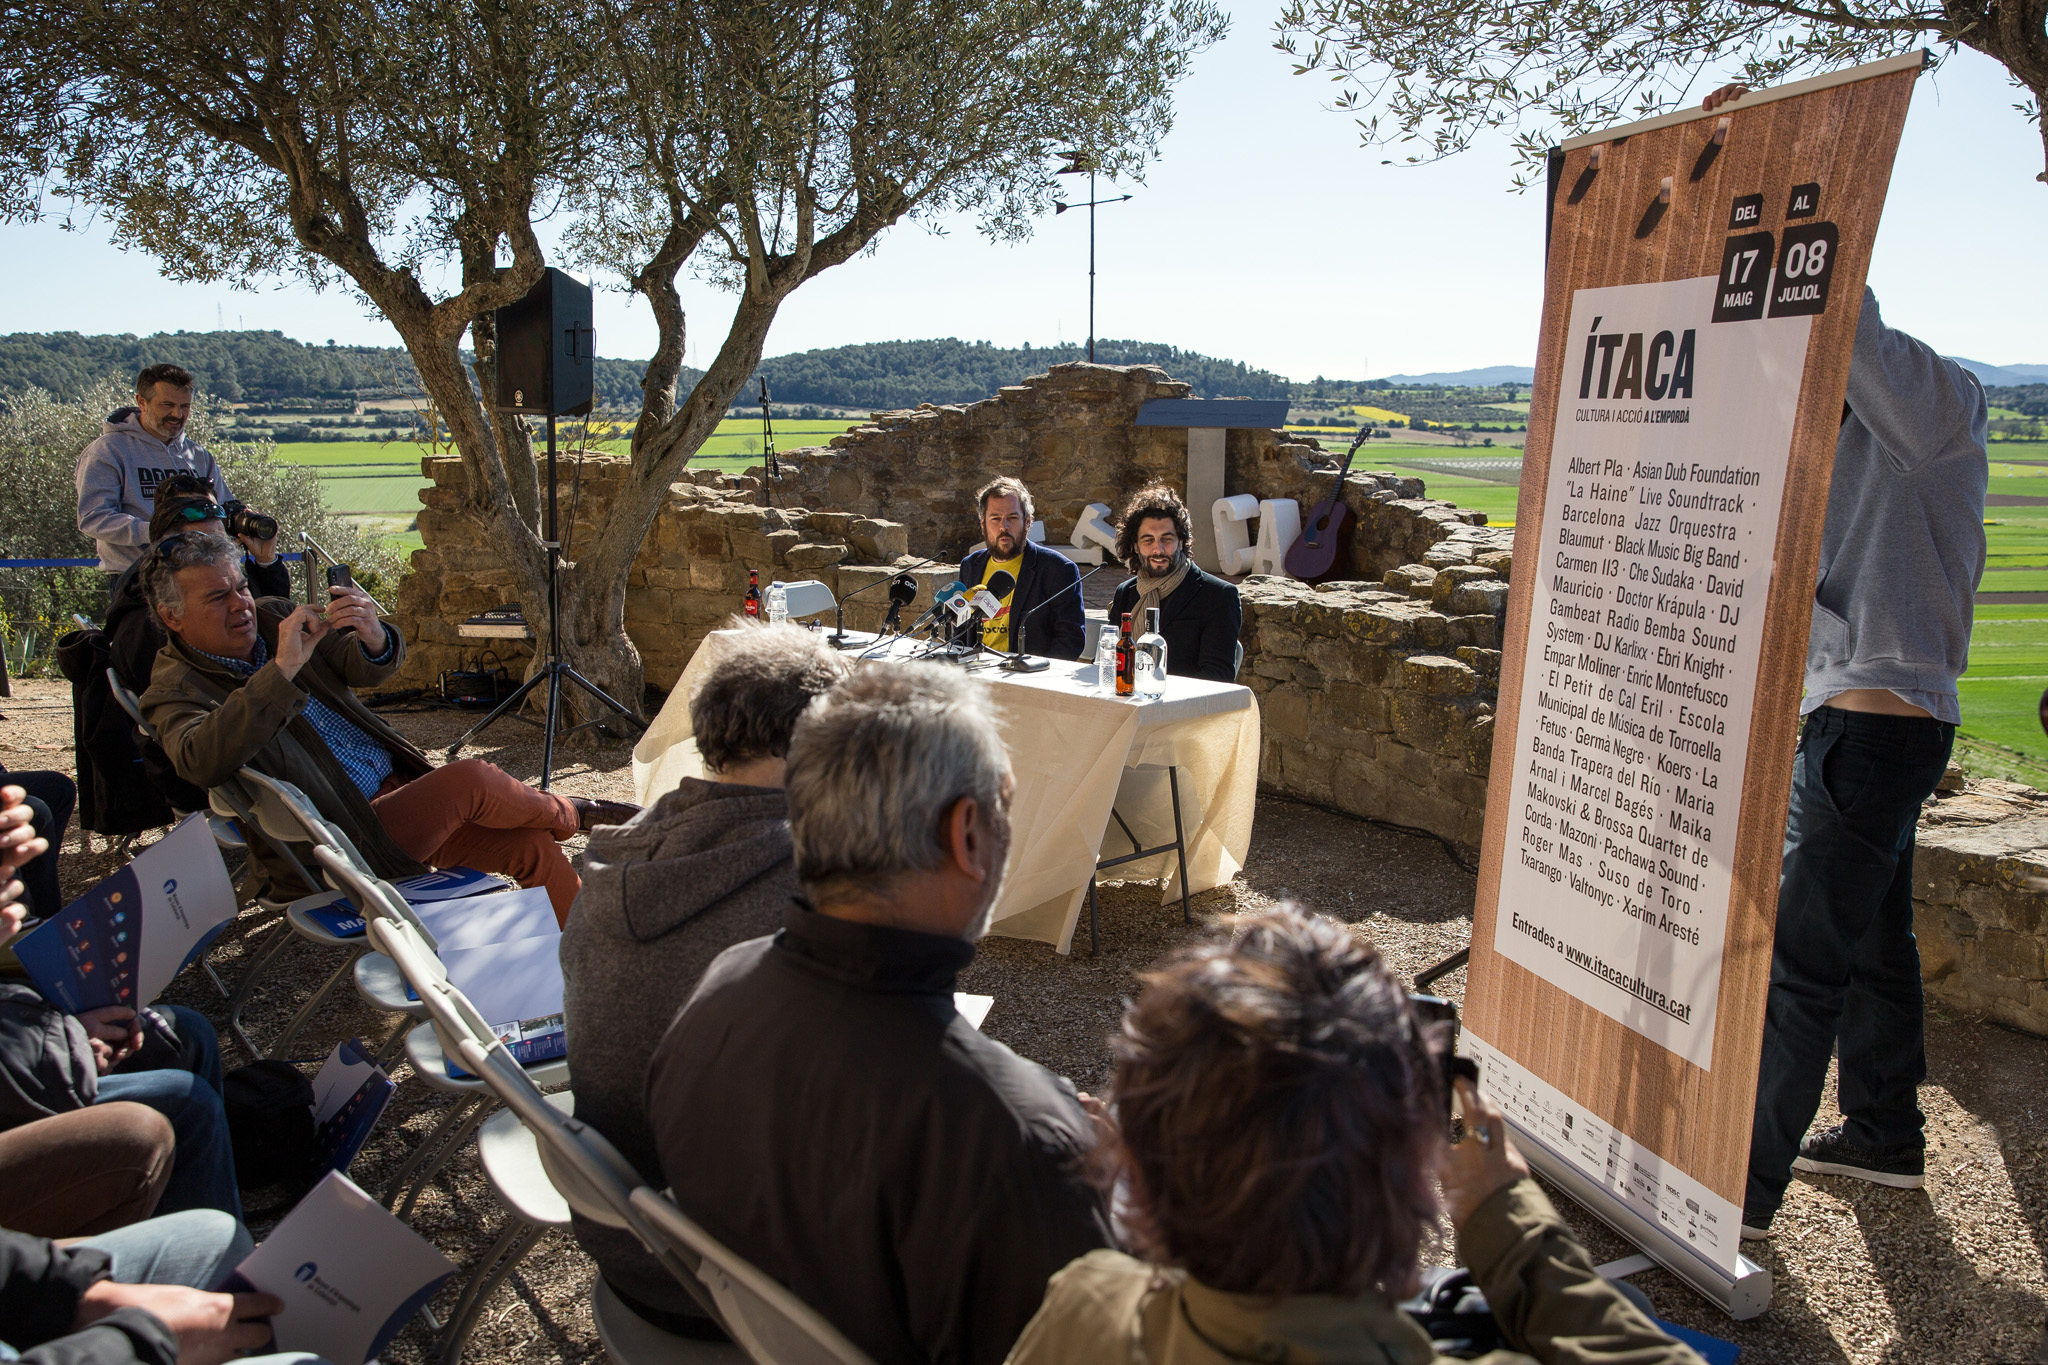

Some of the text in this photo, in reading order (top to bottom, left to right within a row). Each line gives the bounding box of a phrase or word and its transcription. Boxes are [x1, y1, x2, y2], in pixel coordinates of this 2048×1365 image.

[1735, 205, 1757, 222] DEL
[1793, 195, 1810, 212] AL
[1728, 249, 1760, 285] 17
[1785, 239, 1828, 279] 08
[1722, 290, 1754, 308] MAIG
[1777, 284, 1821, 303] JULIOL
[1579, 316, 1696, 401] ÍTACA
[1576, 407, 1690, 424] CULTURA I ACCIÓ A L'EMPORDÀ
[1568, 457, 1760, 486] Albert Pla Asian Dub Foundation
[1563, 505, 1737, 540] Barcelona Jazz Orquestra
[1640, 487, 1663, 505] Live
[1668, 489, 1745, 513] Soundtrack
[1556, 552, 1598, 573] Carmen
[1629, 562, 1649, 582] Che
[1652, 566, 1695, 590] Sudaka
[1707, 575, 1745, 598] David
[1559, 528, 1741, 569] Blaumut Black Music Big Band
[904, 580, 917, 591] acn
[1553, 575, 1740, 626] Mauricio Doctor Krápula DJ
[1547, 622, 1725, 680] System DJ Karlixx Ebri Knight
[1550, 598, 1737, 653] Gambeat Radio Bemba Sound
[1544, 645, 1729, 708] Empar Moliner Enric Montefusco
[1549, 670, 1725, 735] El Petit de Cal Eril Escola
[1538, 691, 1721, 762] Municipal de Música de Torroella
[1541, 715, 1718, 789] Fetus Germà Negre Koers La
[1530, 760, 1712, 842] Arnal i Marcel Bagés Maika
[1533, 736, 1715, 816] Banda Trapera del Río Maria
[1525, 804, 1699, 891] Corda Mazoni Pachawa Sound
[1528, 782, 1709, 868] Makovski & Brossa Quartet de
[1521, 848, 1700, 945] Txarango Valtonyc Xarim Aresté
[1523, 826, 1691, 914] Roger Mas Suso de Toro
[1513, 912, 1691, 1021] Entrades a www.itacacultura.cat
